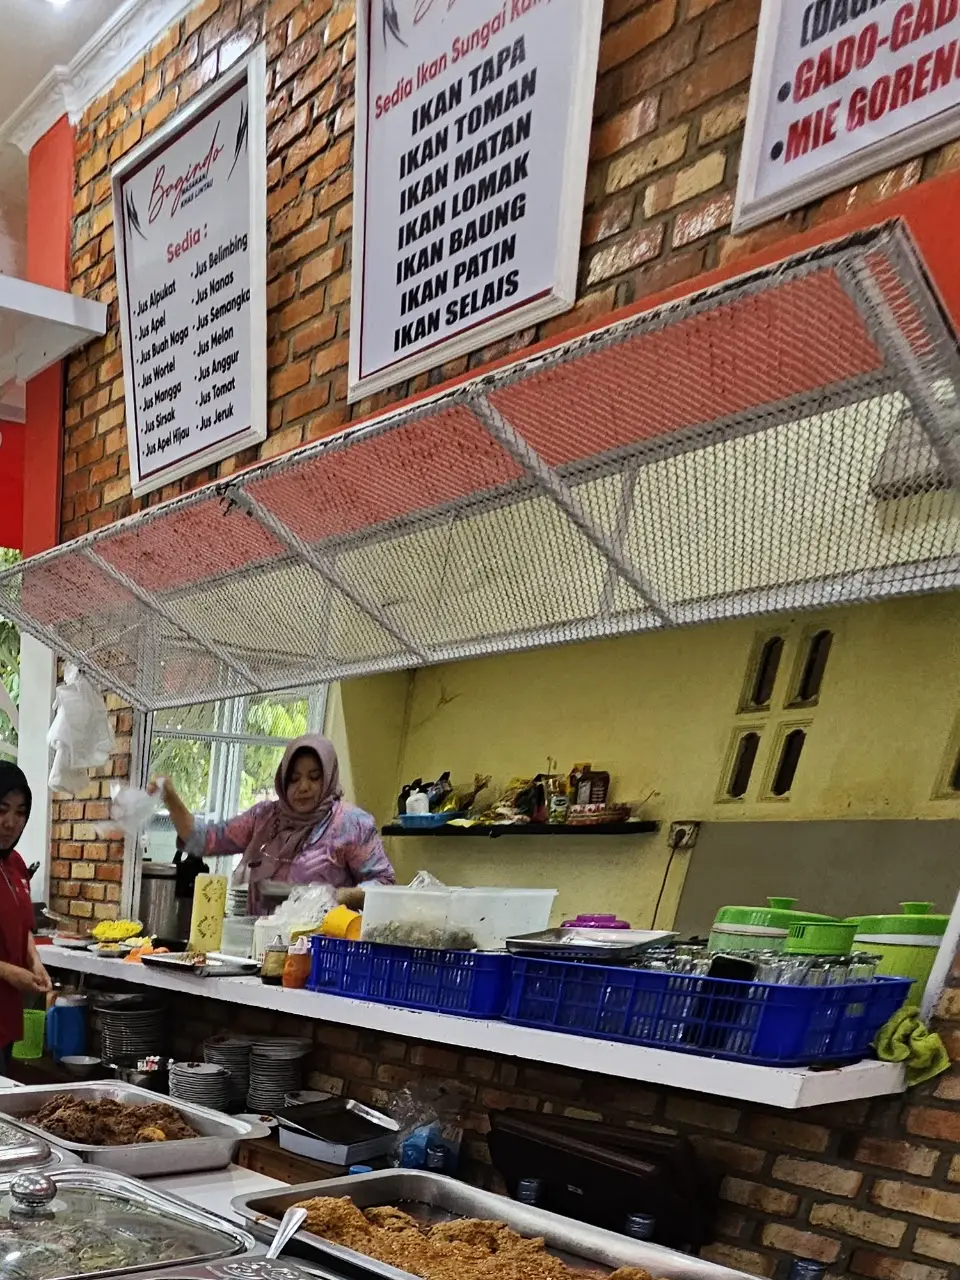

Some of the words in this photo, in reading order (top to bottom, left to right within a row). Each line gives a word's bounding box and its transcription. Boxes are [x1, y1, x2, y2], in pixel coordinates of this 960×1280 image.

[375, 76, 413, 119] Sedia
[416, 52, 447, 90] Ikan
[451, 2, 507, 65] Sungai
[411, 77, 462, 137] IKAN
[469, 34, 527, 98] TAPA
[399, 124, 449, 181] IKAN
[455, 67, 538, 144] TOMAN
[784, 97, 843, 165] MIE
[399, 163, 449, 216] IKAN
[454, 109, 532, 183] MATAN
[398, 200, 446, 252] IKAN
[451, 150, 530, 221] LOMAK
[166, 228, 201, 264] Sedia
[194, 260, 208, 279] Jus
[209, 232, 248, 267] Belimbing
[396, 238, 444, 286] IKAN
[448, 192, 527, 257] BAUNG
[196, 286, 208, 305] Jus
[209, 270, 234, 297] Nanas
[400, 272, 448, 318] IKAN
[452, 233, 517, 290] PATIN
[137, 299, 148, 317] Jus
[149, 280, 176, 309] Alpukat
[197, 312, 210, 331] Jus
[210, 288, 250, 323] Semangka
[393, 306, 440, 353] IKAN
[445, 270, 520, 326] SELAIS
[138, 324, 150, 341] Jus
[151, 315, 166, 336] Apel
[140, 346, 151, 364] Jus
[152, 336, 169, 356] Buah
[170, 325, 189, 350] Naga
[197, 338, 210, 358] Jus
[211, 325, 234, 350] Melon
[141, 370, 152, 387] Jus
[153, 356, 176, 381] Wortel
[198, 363, 211, 382] Jus
[211, 350, 240, 377] Anggur
[143, 394, 154, 412] Jus
[155, 380, 182, 407] Mangga
[199, 388, 212, 407] Jus
[212, 377, 236, 401] Tomat
[144, 418, 155, 435] Jus
[156, 407, 176, 431] Sirsak
[200, 412, 213, 432] Jus
[214, 402, 234, 427] Jeruk
[145, 441, 156, 458] Jus
[157, 430, 172, 453] Apel
[173, 425, 190, 446] Hijau
